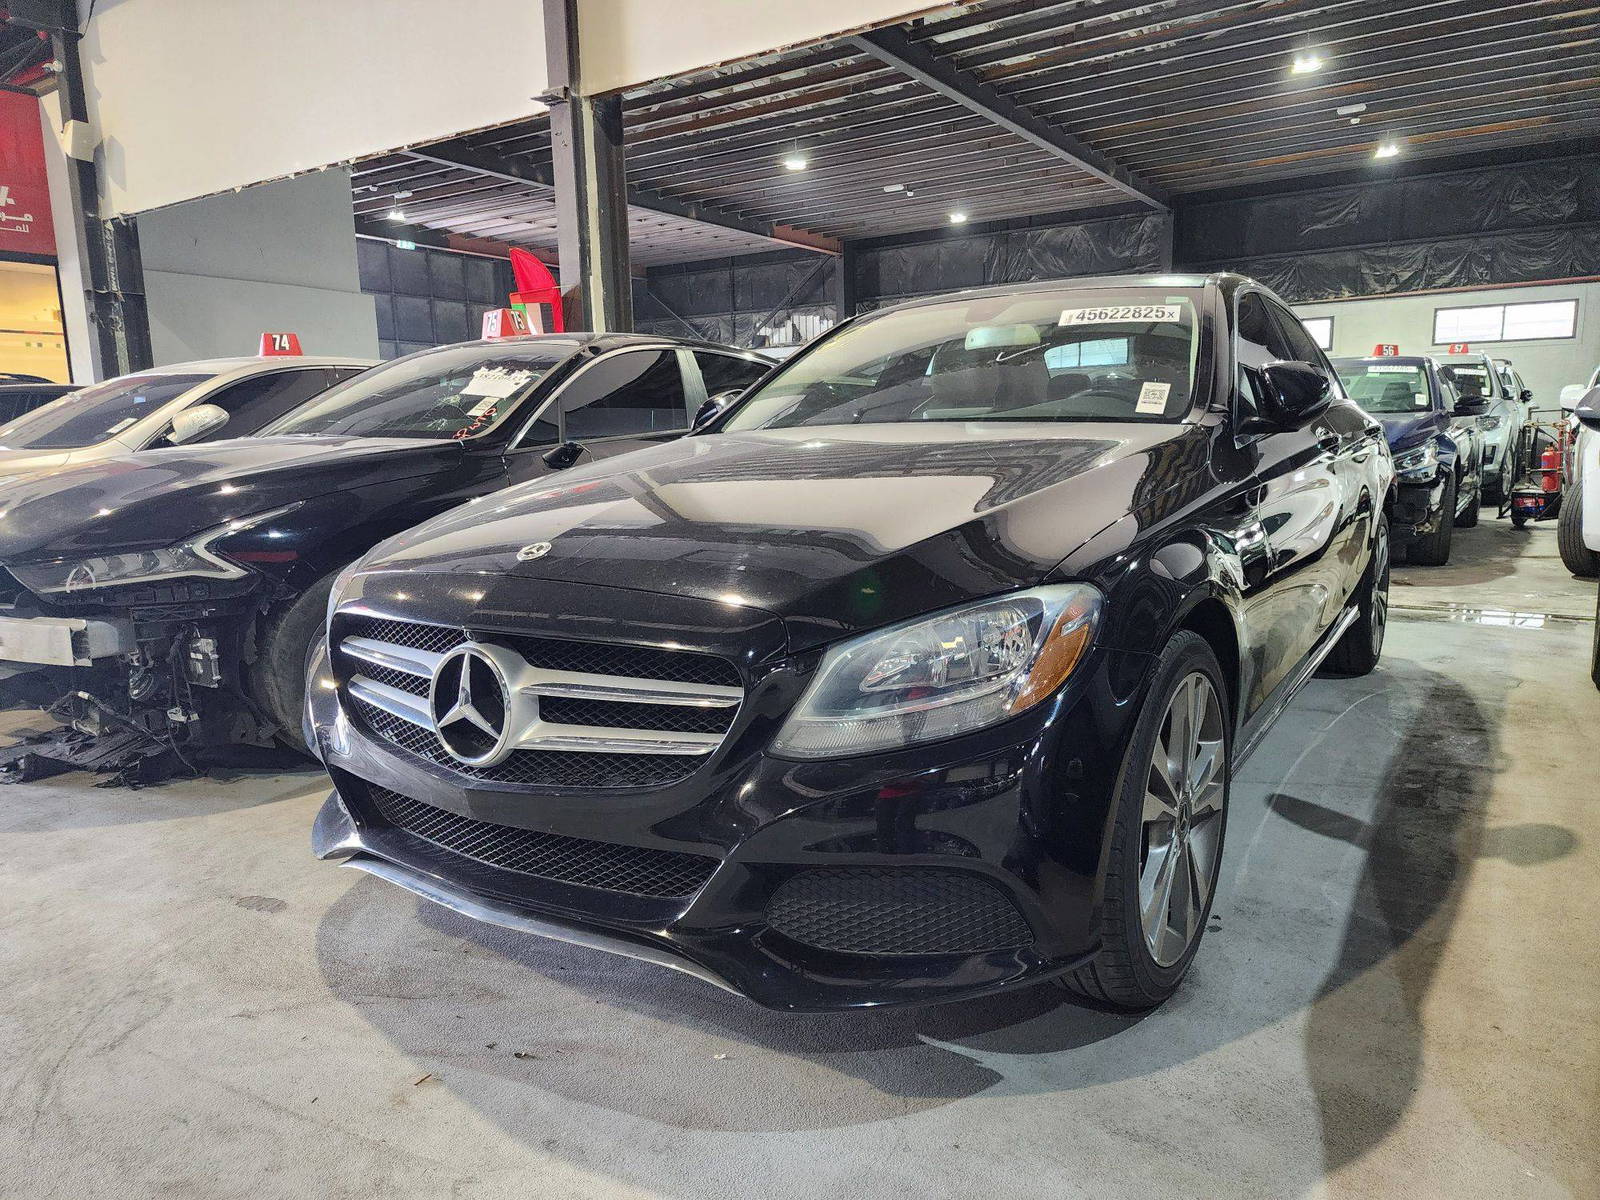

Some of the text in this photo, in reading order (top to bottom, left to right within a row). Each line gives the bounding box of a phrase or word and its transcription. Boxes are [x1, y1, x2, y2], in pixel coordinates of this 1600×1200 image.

[486, 311, 498, 332] 75
[509, 310, 526, 330] 75
[271, 334, 290, 351] 74
[1382, 345, 1394, 356] 56
[1453, 344, 1464, 353] 57
